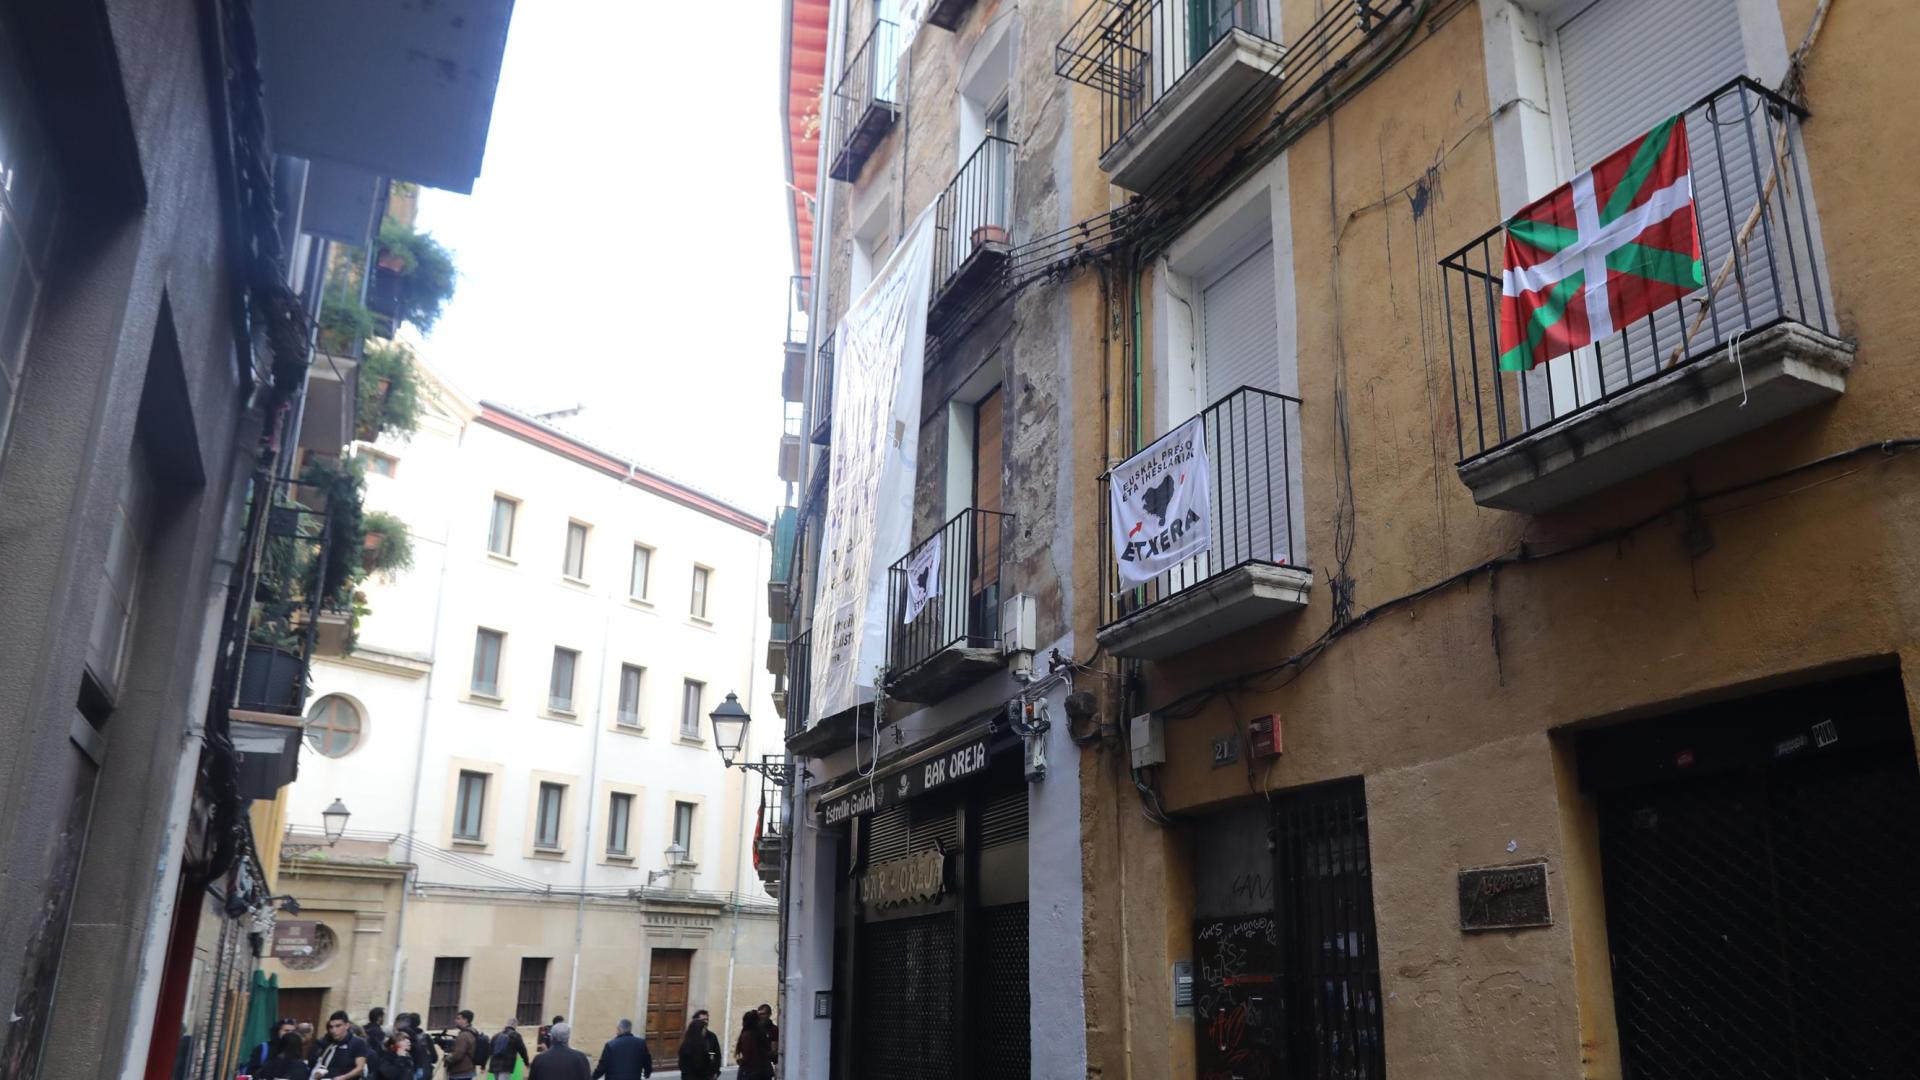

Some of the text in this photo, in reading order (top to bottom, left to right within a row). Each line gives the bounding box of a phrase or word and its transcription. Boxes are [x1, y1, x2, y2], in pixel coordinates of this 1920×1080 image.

[1122, 448, 1194, 502] ETA IHESLARIAK
[1123, 441, 1193, 491] EUSKAL PRESO
[1121, 508, 1200, 562] ETXERA
[924, 742, 985, 789] BAR OREJA
[1215, 741, 1228, 760] 21
[825, 801, 849, 824] Estrella
[862, 871, 885, 902] BAR
